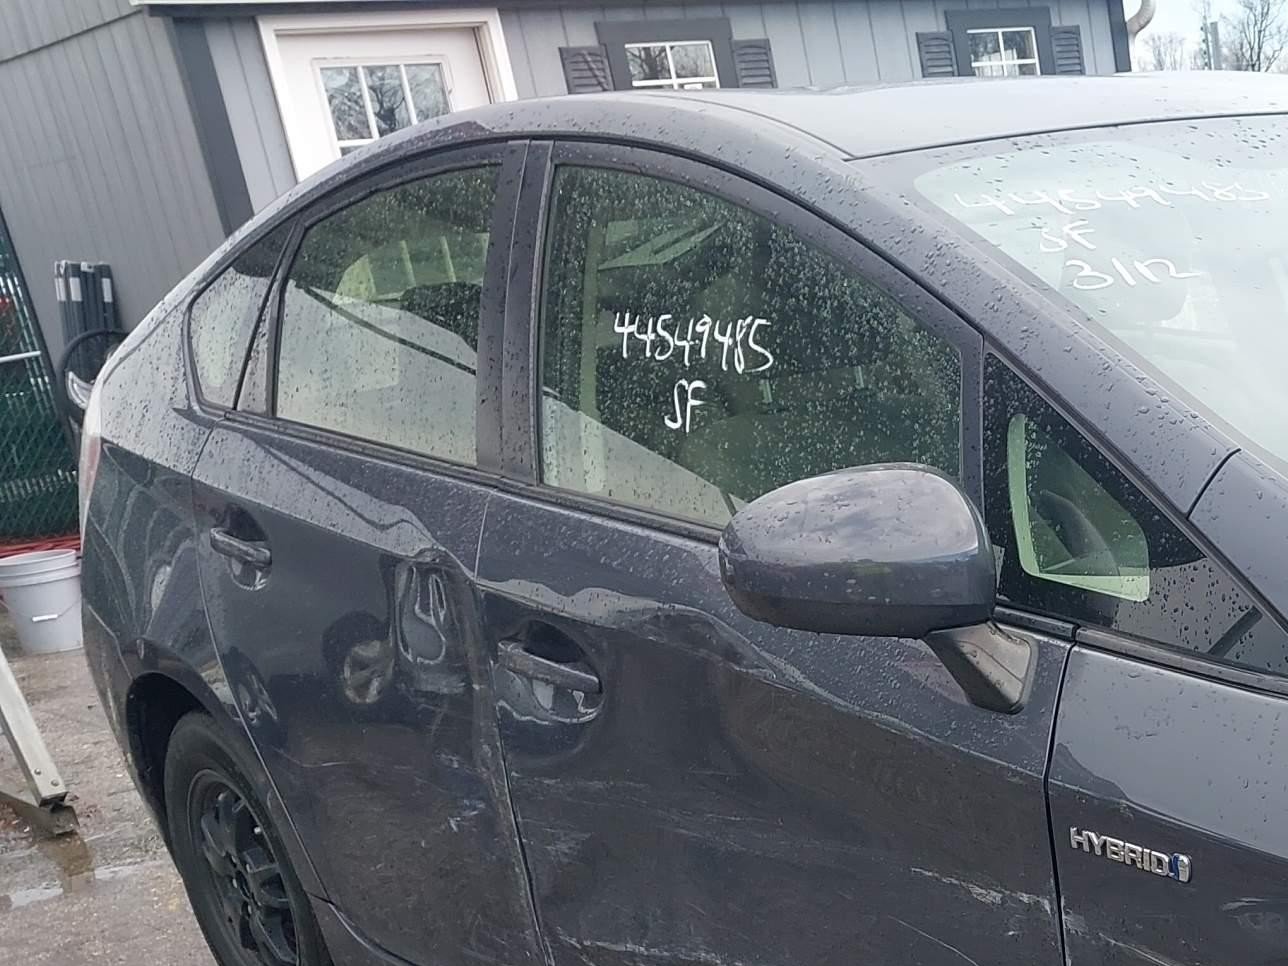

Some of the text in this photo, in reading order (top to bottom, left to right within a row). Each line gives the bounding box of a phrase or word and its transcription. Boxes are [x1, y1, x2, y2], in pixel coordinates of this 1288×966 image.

[954, 180, 1271, 216] 44549485
[1039, 219, 1097, 253] SF
[613, 311, 774, 375] 44549485
[663, 378, 706, 433] SF
[1069, 826, 1170, 877] HYBRID
